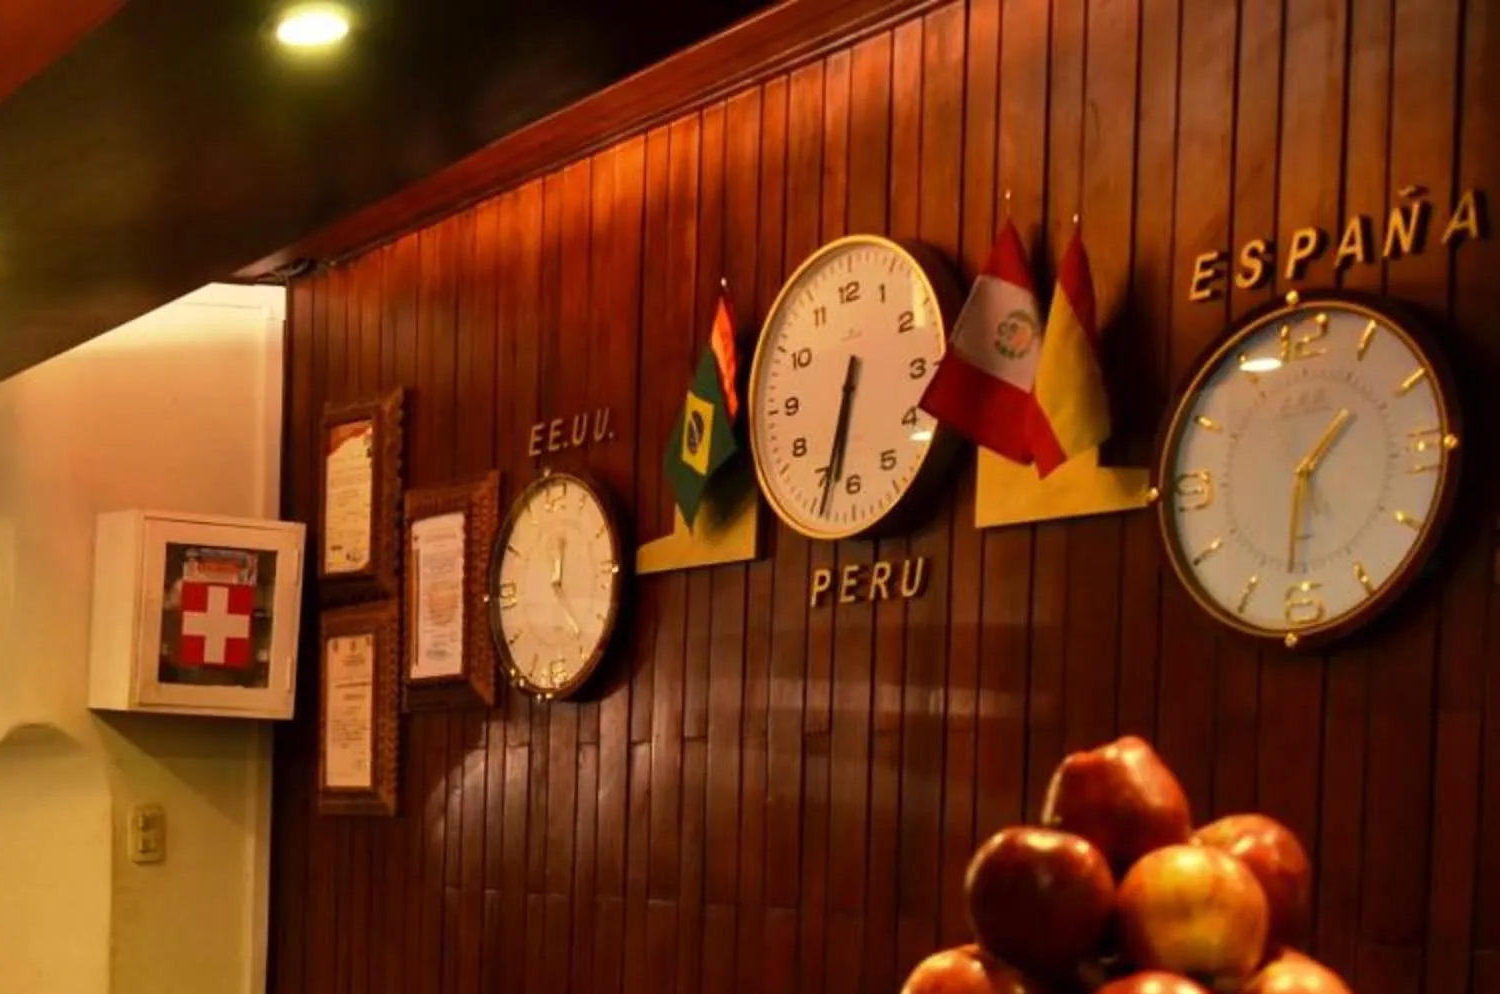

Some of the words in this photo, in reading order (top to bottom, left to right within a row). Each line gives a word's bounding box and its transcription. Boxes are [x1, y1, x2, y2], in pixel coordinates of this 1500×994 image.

[1189, 184, 1480, 300] ESPAÑA
[838, 280, 861, 304] 12
[813, 304, 827, 327] 11
[897, 310, 915, 334] 2
[790, 346, 813, 371] 10
[909, 357, 926, 380] 3
[784, 397, 800, 417] 9
[901, 406, 918, 428] 4
[792, 437, 808, 458] 8
[879, 449, 898, 471] 5
[846, 473, 862, 495] 6
[810, 556, 925, 608] PERU
